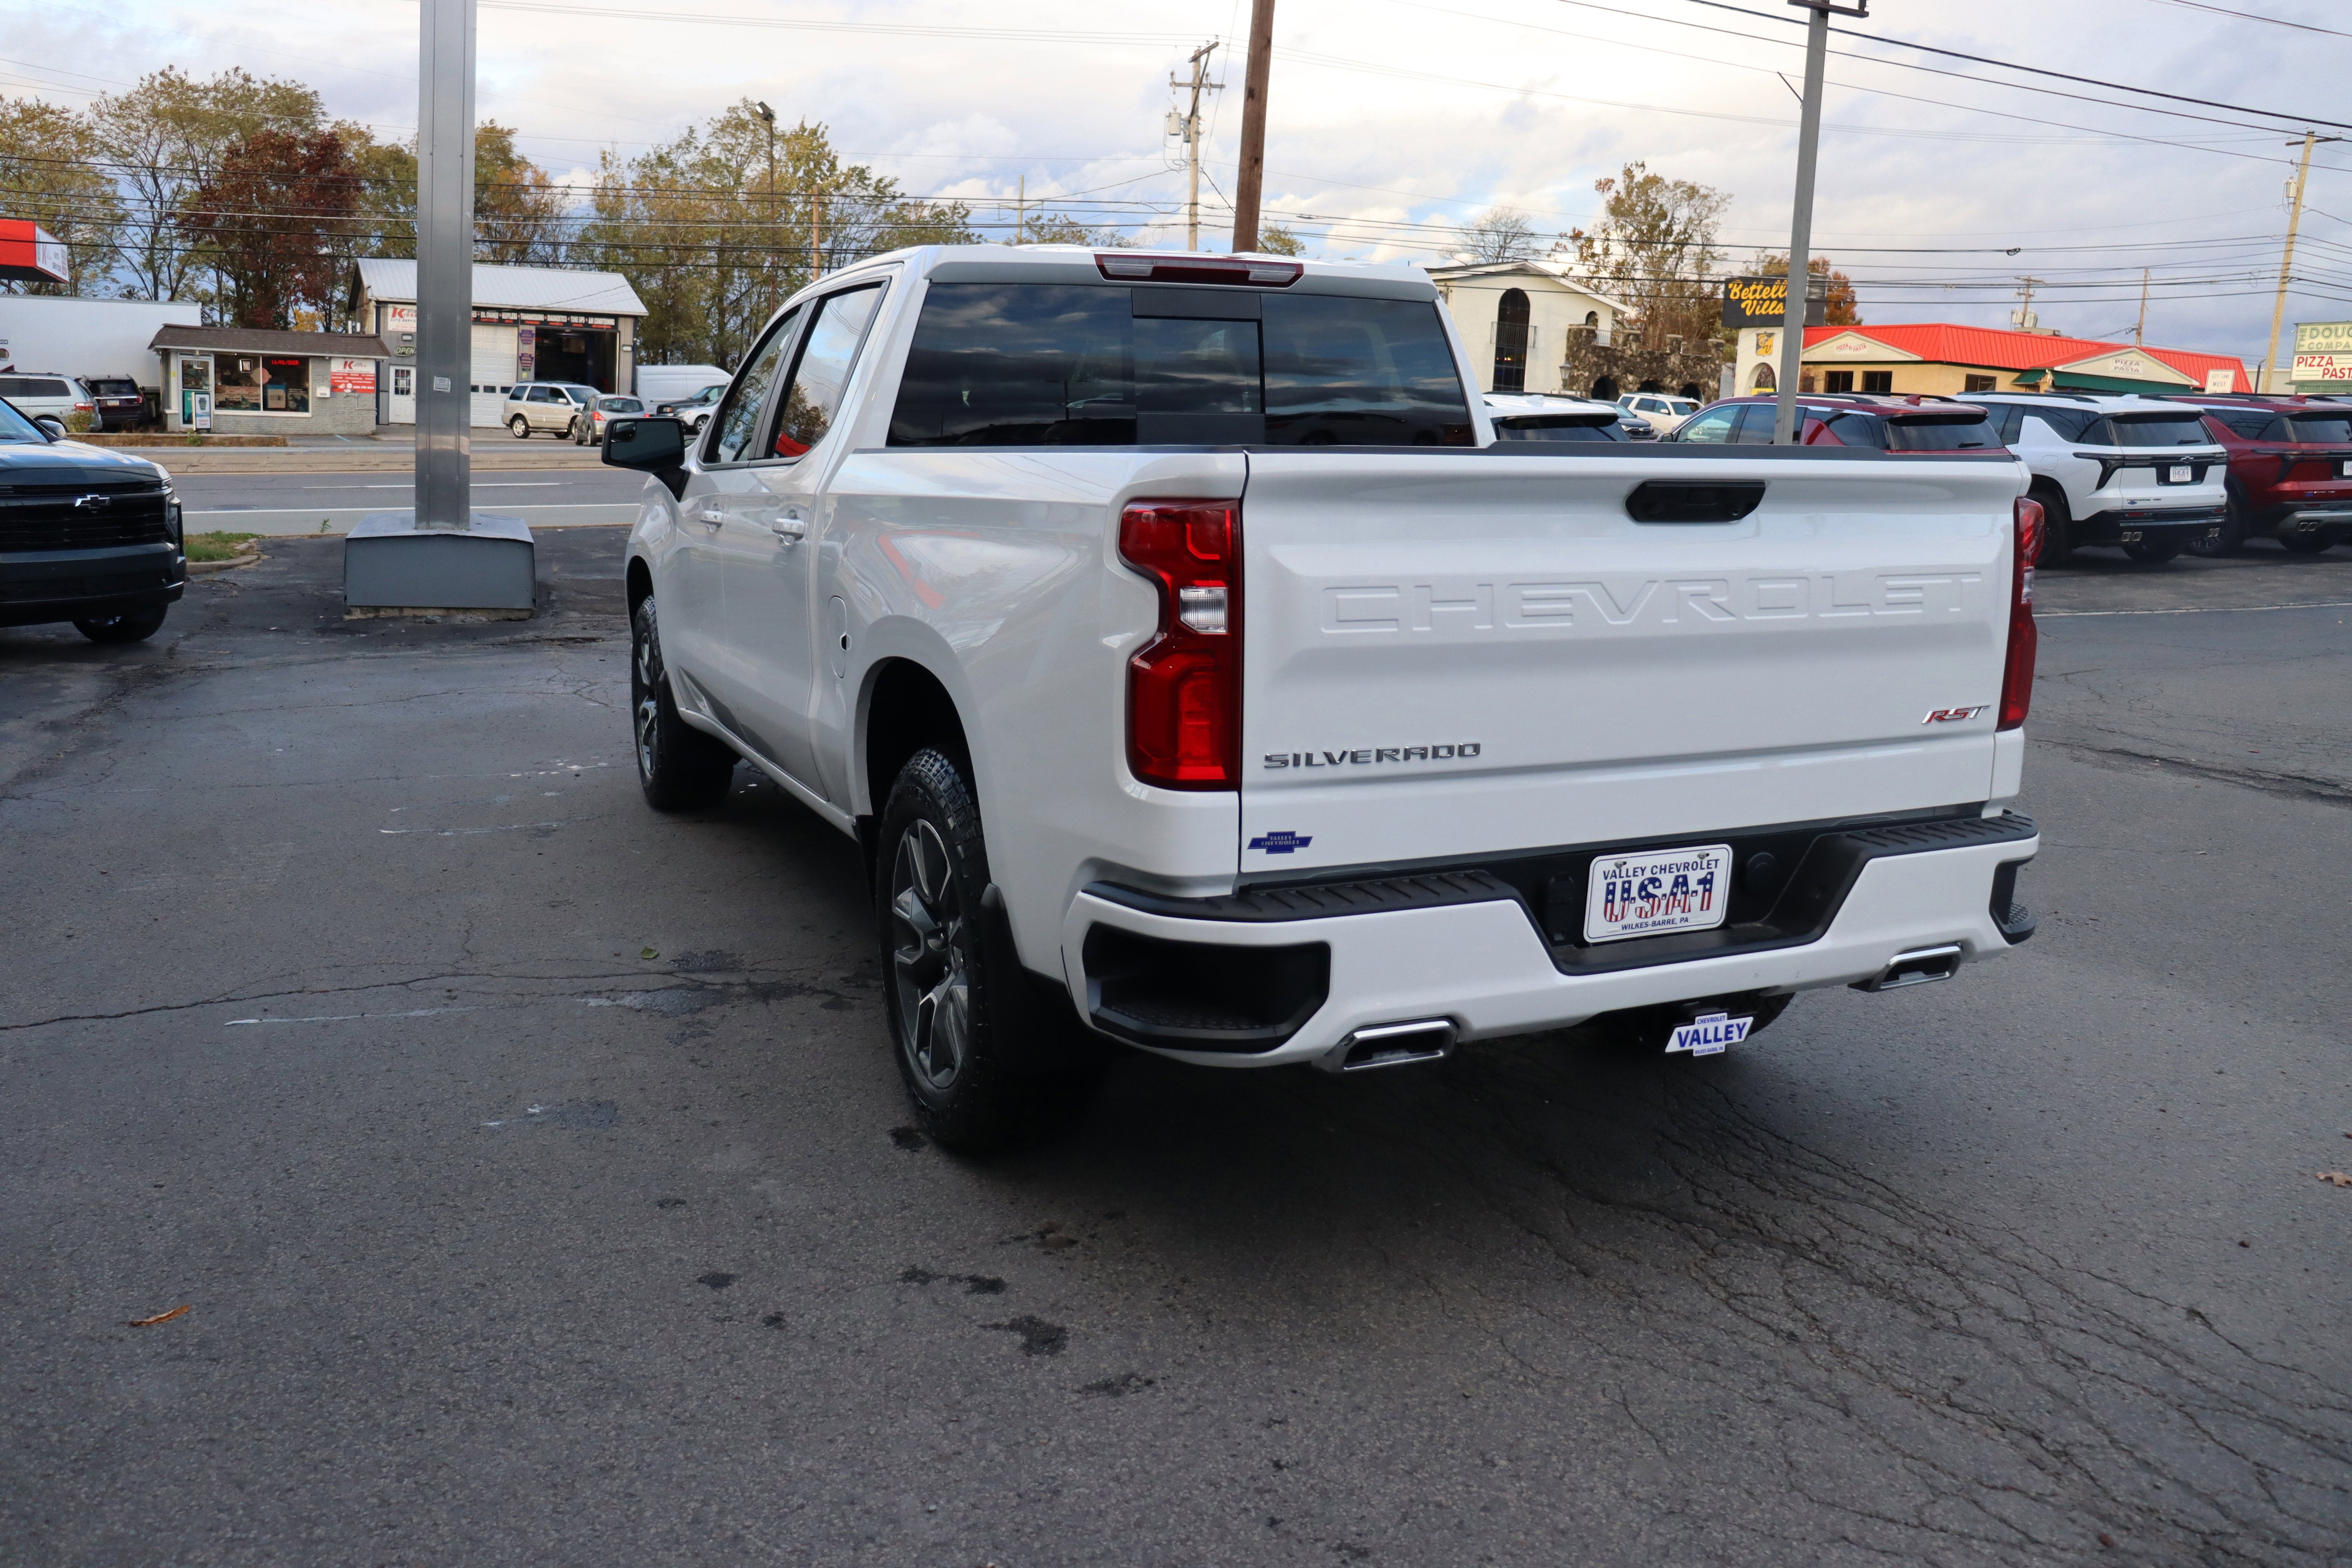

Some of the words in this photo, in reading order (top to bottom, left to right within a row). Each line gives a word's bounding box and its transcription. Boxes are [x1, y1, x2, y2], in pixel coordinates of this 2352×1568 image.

[1728, 279, 1788, 301] Bettell
[1741, 300, 1786, 316] Villa
[520, 313, 544, 321] TRANSMISSIONS
[547, 314, 567, 323] DIAGNOSTICS
[2297, 327, 2307, 350] THE
[1853, 344, 1866, 353] PASTA
[2296, 356, 2333, 367] PIZZA
[2322, 367, 2352, 379] PAST
[1321, 571, 1981, 633] CHEVROLET
[1921, 705, 1991, 724] RST
[1264, 742, 1481, 768] SILVERADO
[1603, 866, 1647, 880] VALLEY
[1650, 859, 1719, 875] CHEVROLET
[1621, 918, 1677, 931] WILKES-BARRE,
[1697, 1015, 1726, 1025] CHEVROLET
[1677, 1022, 1747, 1048] VALLEY
